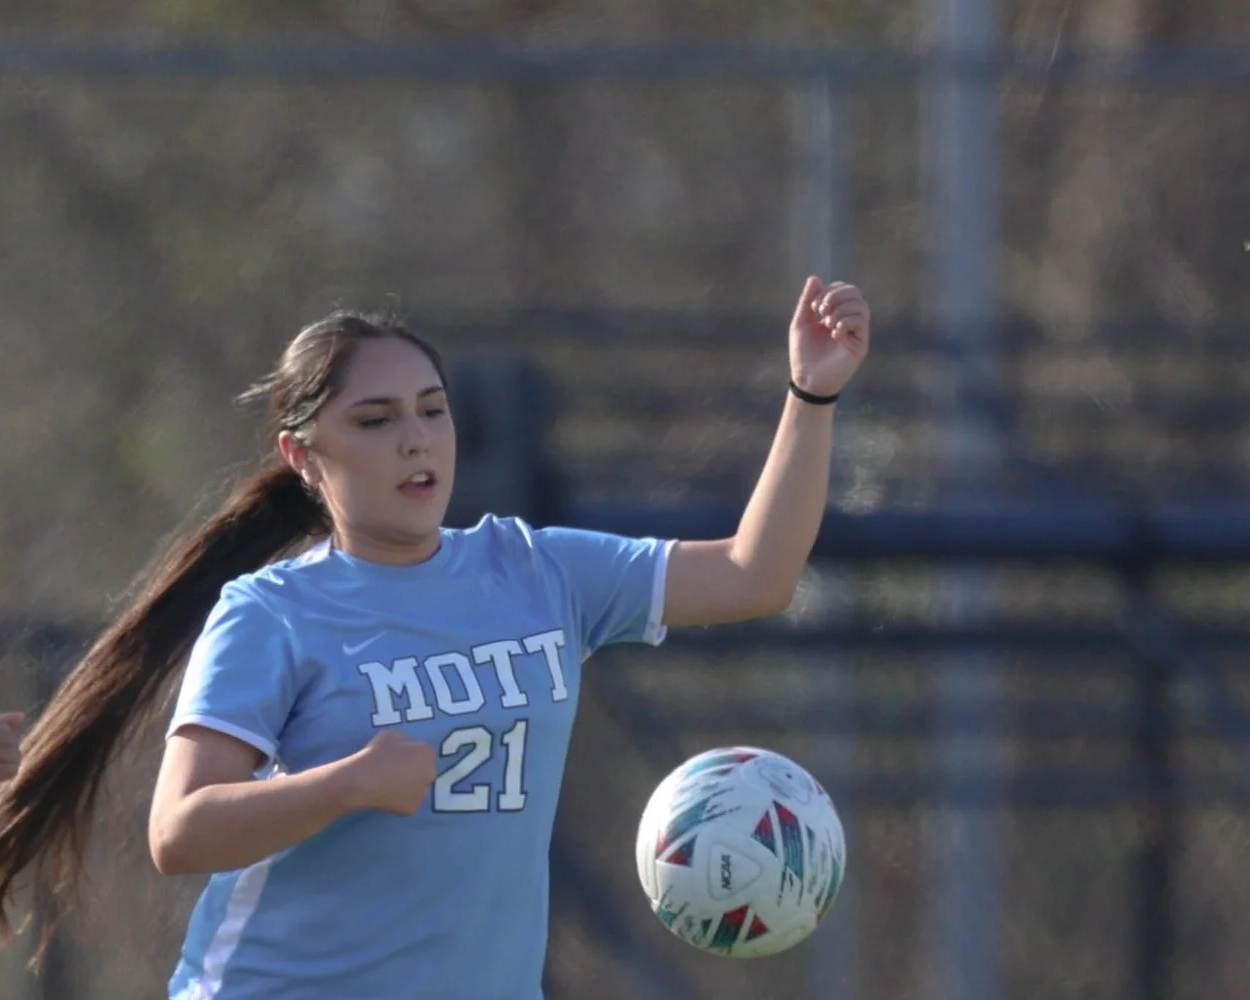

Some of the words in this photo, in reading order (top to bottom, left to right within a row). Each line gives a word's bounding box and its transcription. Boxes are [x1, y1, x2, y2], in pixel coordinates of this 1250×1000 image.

[357, 628, 568, 728] MOTT
[432, 718, 528, 814] 21
[721, 854, 732, 890] NCAA
